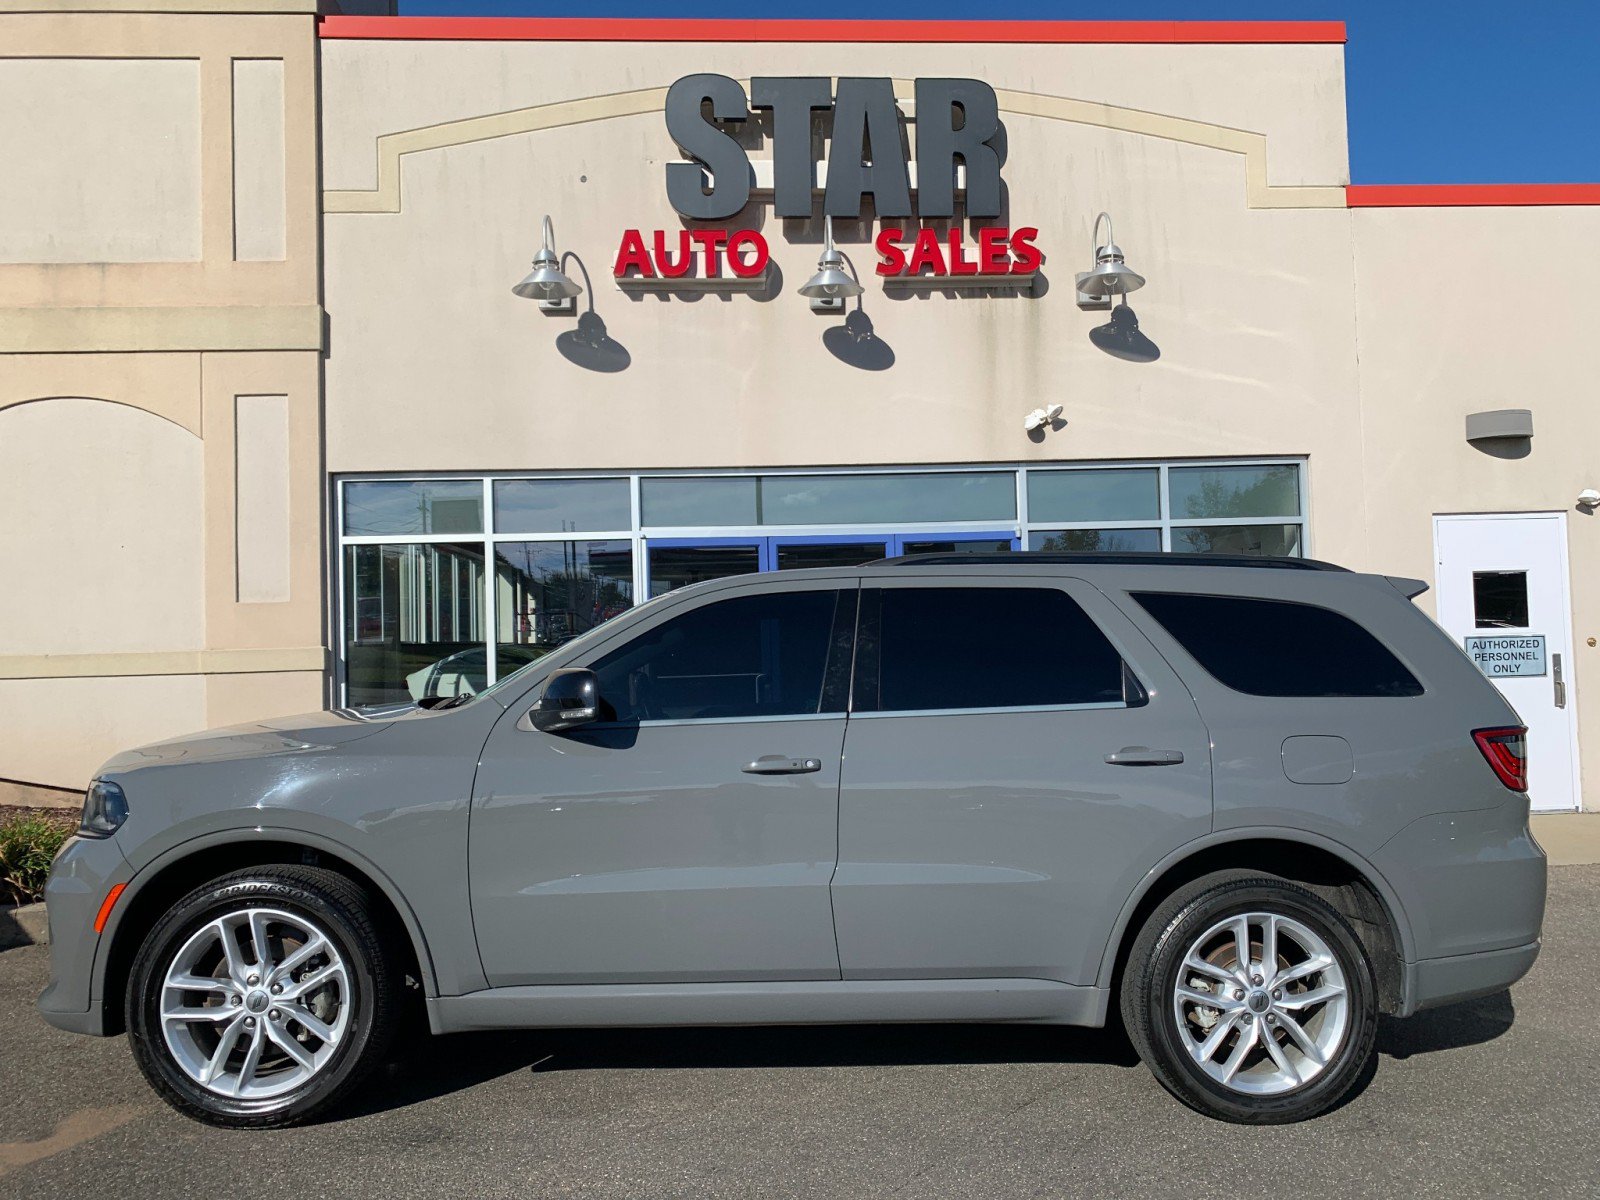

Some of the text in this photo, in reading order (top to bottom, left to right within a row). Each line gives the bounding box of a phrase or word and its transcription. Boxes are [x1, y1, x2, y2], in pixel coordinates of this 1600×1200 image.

[665, 73, 1000, 219] STAR
[614, 227, 1042, 278] AUTO SALES
[1472, 640, 1539, 649] AUTHORIZED
[1474, 651, 1539, 661] PERSONNEL
[1493, 664, 1521, 673] ONLY
